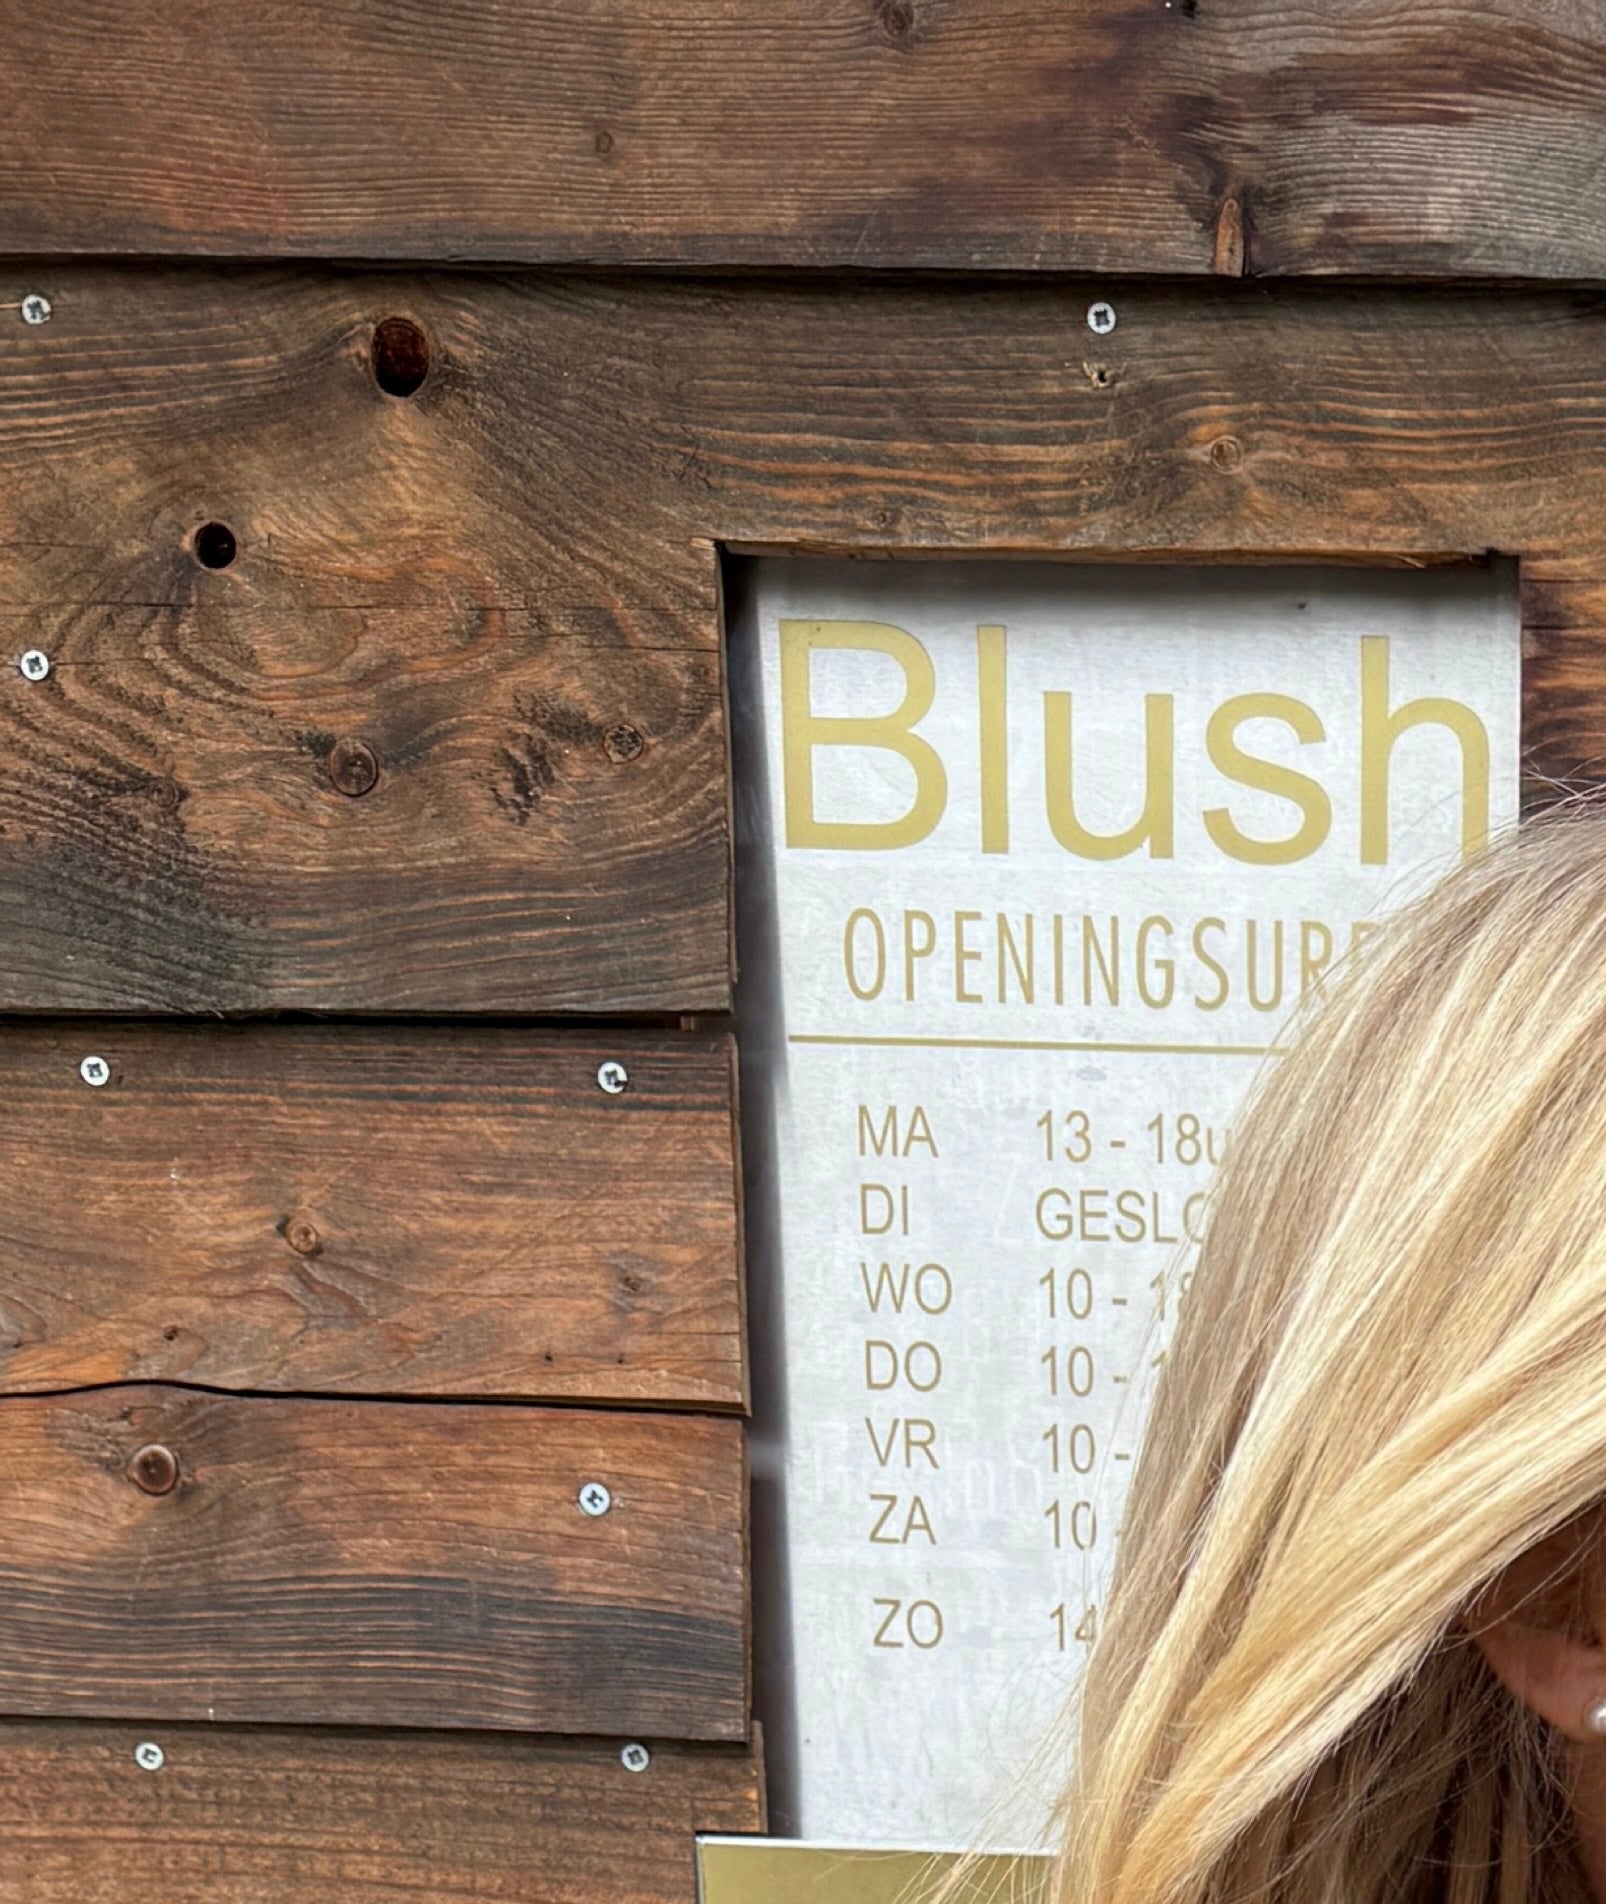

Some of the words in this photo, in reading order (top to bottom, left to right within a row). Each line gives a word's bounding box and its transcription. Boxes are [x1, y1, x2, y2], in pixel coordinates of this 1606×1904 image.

[779, 619, 1490, 866] Blush
[858, 1104, 939, 1158] MA
[1037, 1109, 1092, 1163] 13
[861, 1184, 909, 1236] DI
[860, 1261, 953, 1316] WO
[1039, 1267, 1093, 1320] 10
[865, 1340, 942, 1393] DO
[1041, 1345, 1094, 1397] 10
[865, 1417, 939, 1469] VR
[1043, 1423, 1096, 1474] 10
[869, 1494, 937, 1545] ZA
[1044, 1499, 1097, 1551] 10
[873, 1598, 943, 1649] ZO
[1050, 1602, 1097, 1652] 14
